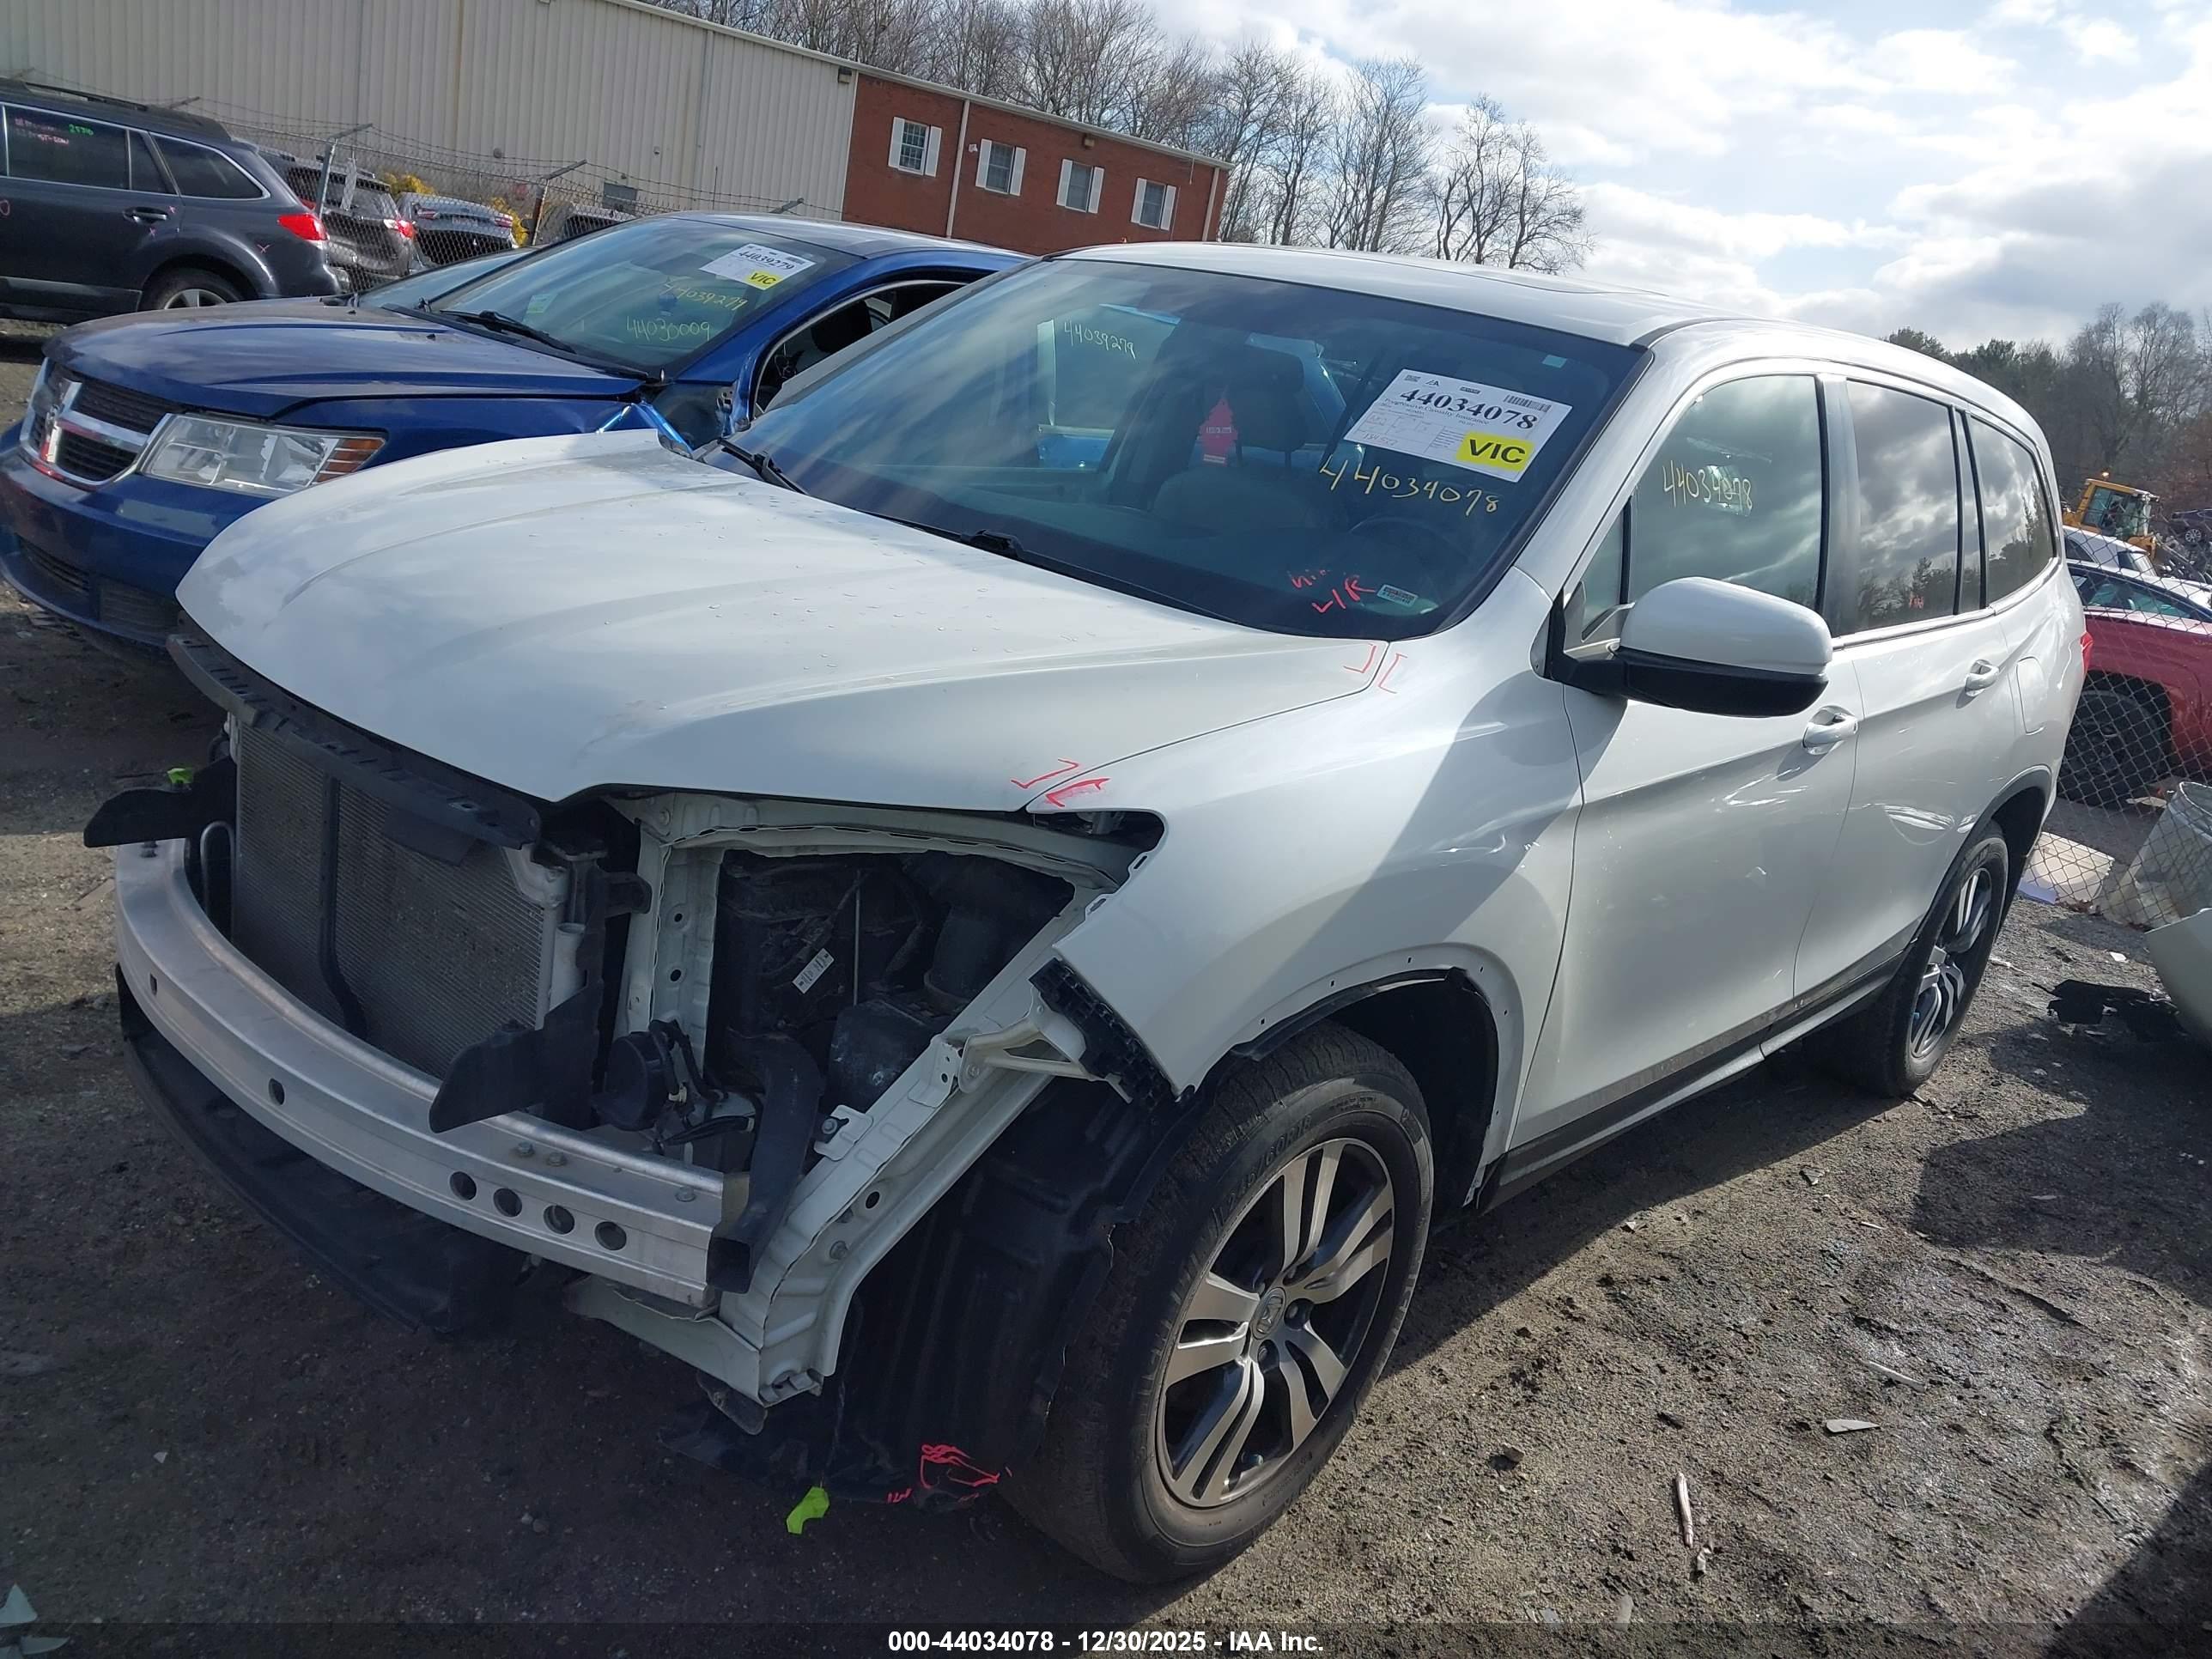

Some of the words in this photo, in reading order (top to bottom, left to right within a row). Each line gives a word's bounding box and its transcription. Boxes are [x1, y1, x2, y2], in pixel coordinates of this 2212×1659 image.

[750, 271, 776, 286] VIC
[1063, 320, 1137, 360] 44039279
[1400, 388, 1538, 429] 44034078
[1468, 438, 1526, 464] VIC
[1320, 455, 1499, 516] 44034078
